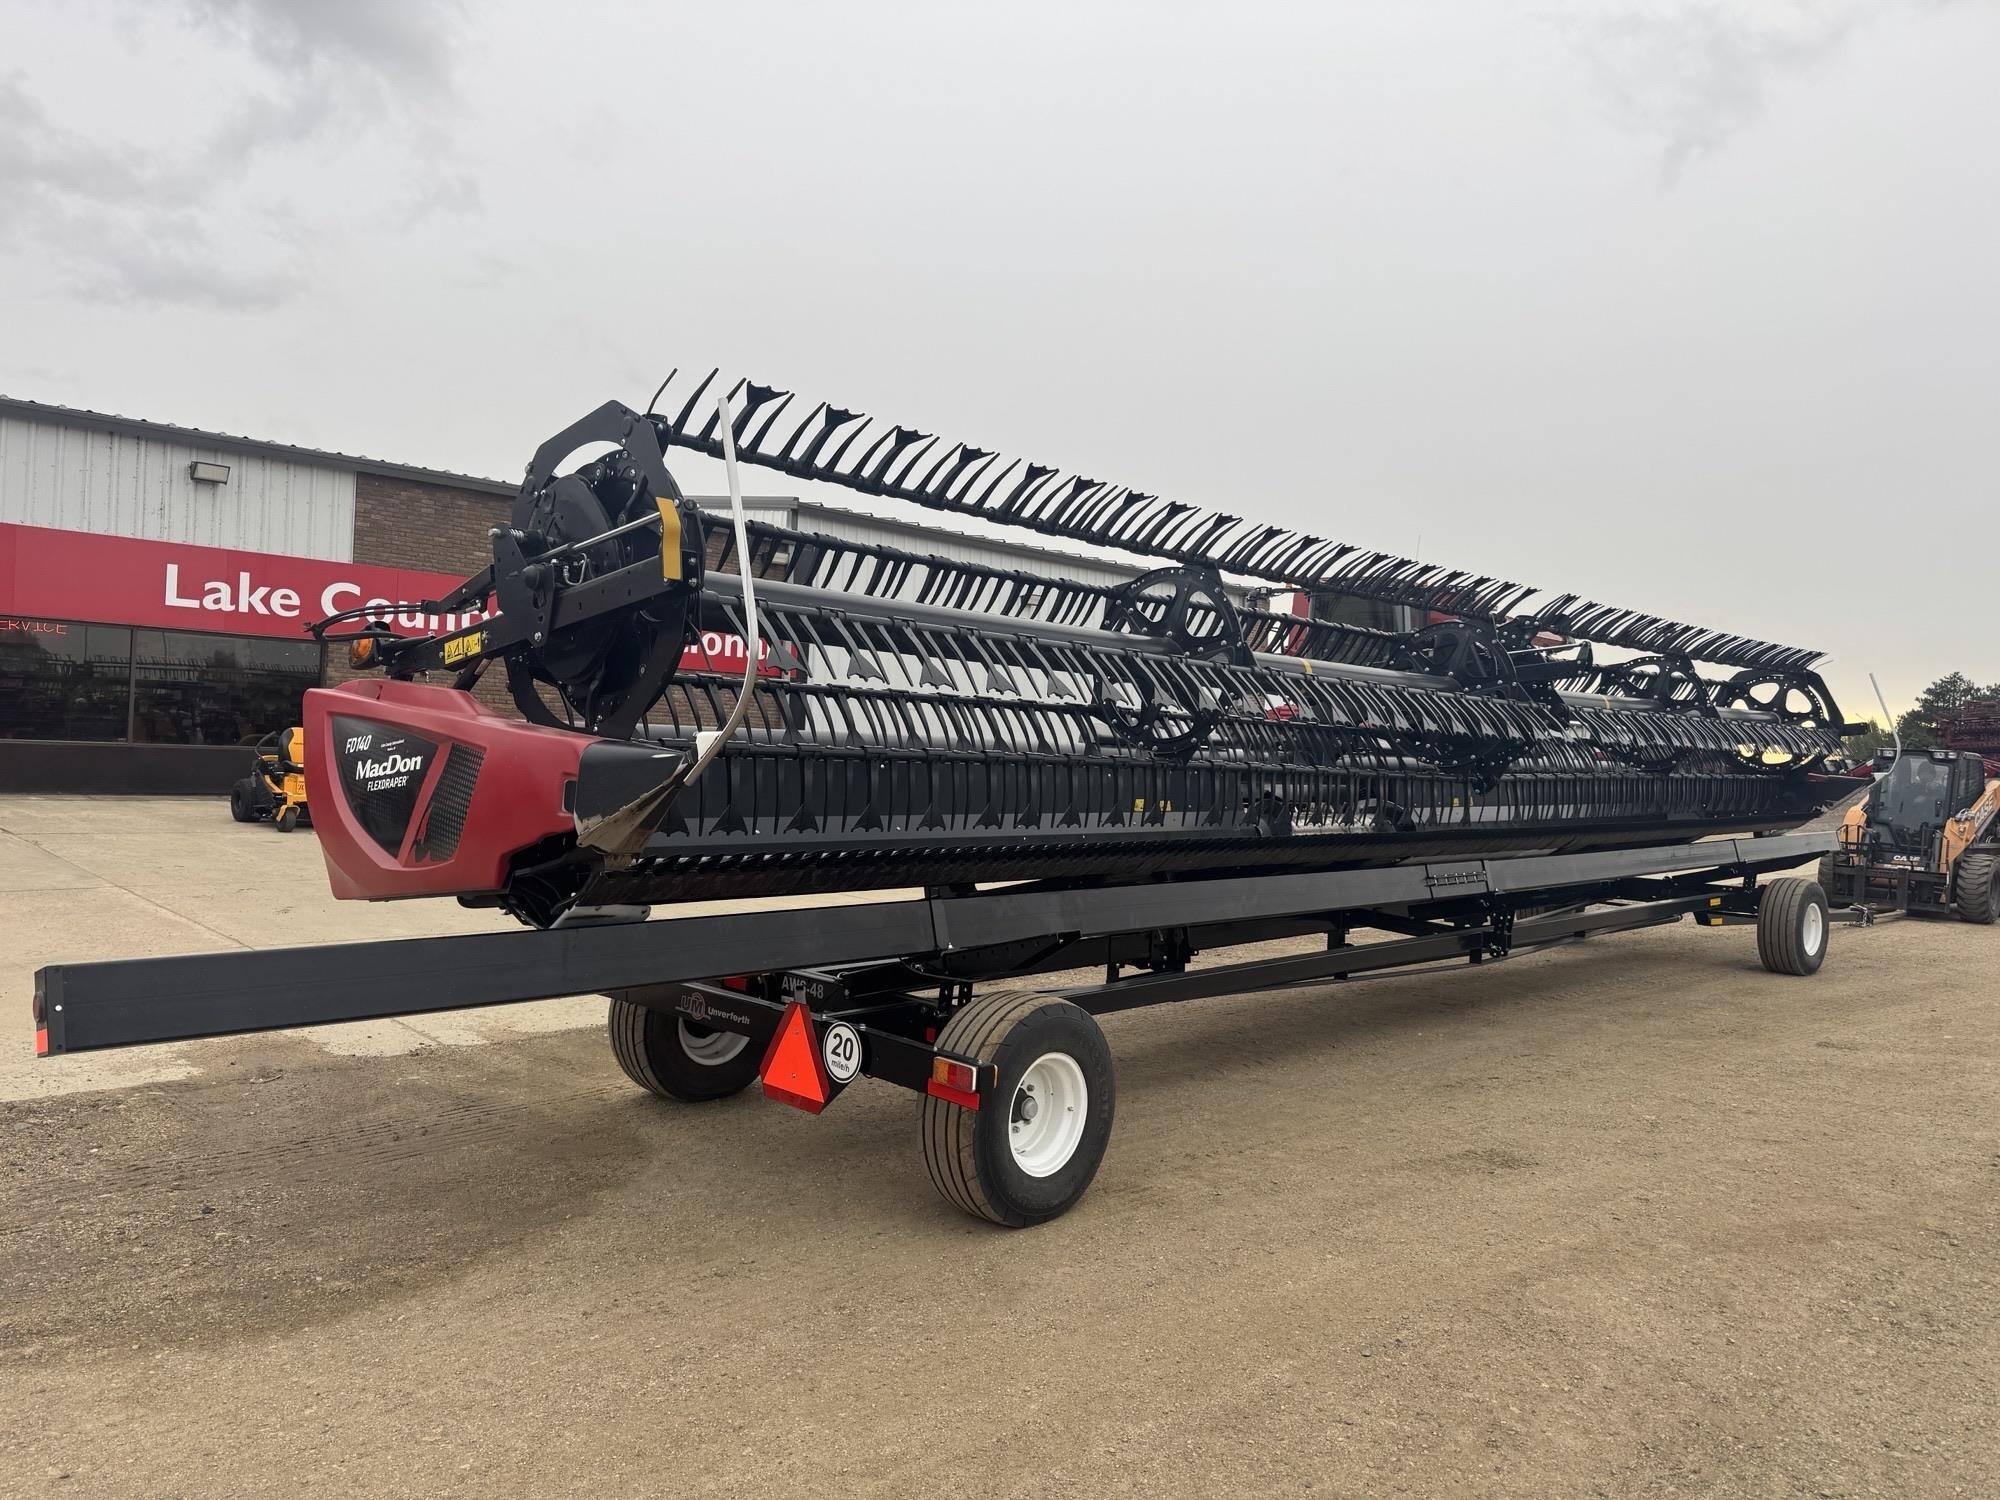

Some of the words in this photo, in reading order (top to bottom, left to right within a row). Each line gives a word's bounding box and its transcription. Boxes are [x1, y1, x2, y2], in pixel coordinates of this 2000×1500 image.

[165, 564, 301, 618] Lake
[320, 582, 505, 632] Coun
[345, 734, 373, 755] FD140
[355, 754, 423, 781] MacDon
[367, 775, 408, 792] FLEXDRAPER
[830, 1032, 854, 1062] 20
